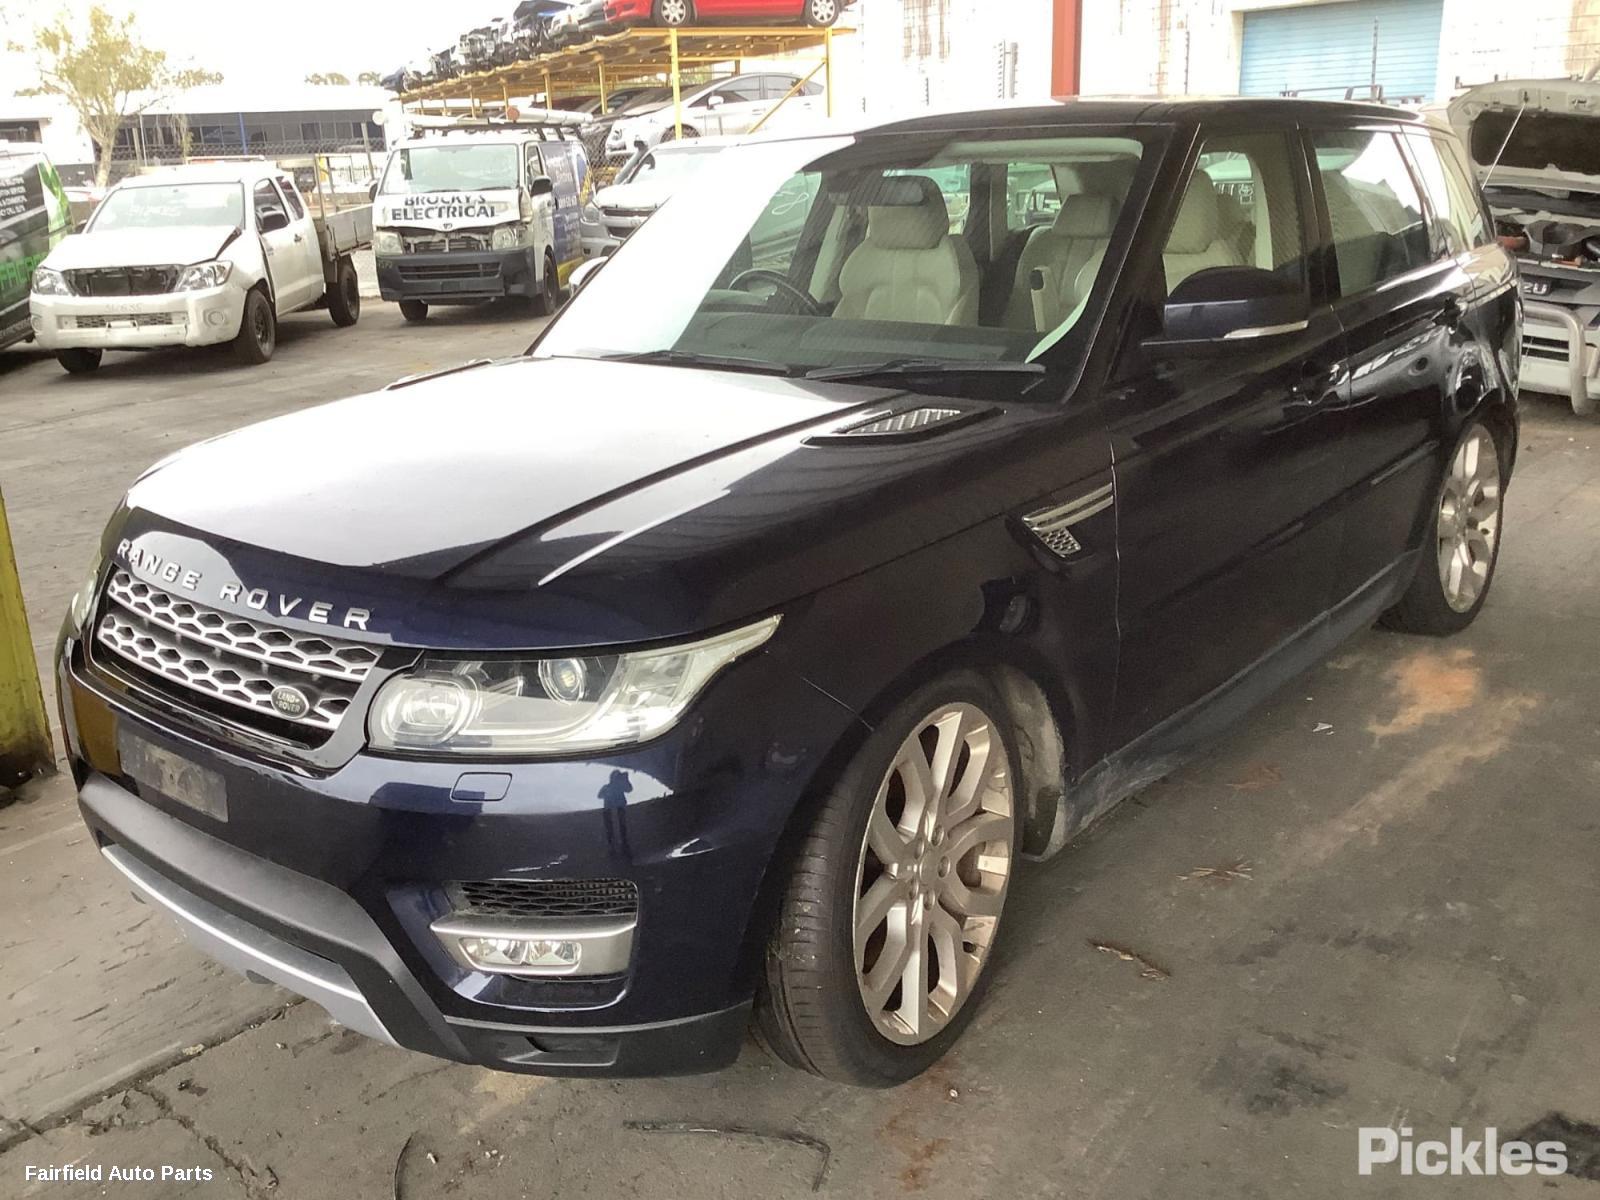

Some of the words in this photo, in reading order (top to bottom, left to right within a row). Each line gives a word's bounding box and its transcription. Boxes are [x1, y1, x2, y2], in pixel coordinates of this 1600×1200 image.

[404, 194, 487, 206] BROCKYS
[117, 538, 202, 591] RANGE
[219, 580, 371, 631] ROVER
[277, 690, 296, 703] LAND
[278, 700, 301, 712] ROVER
